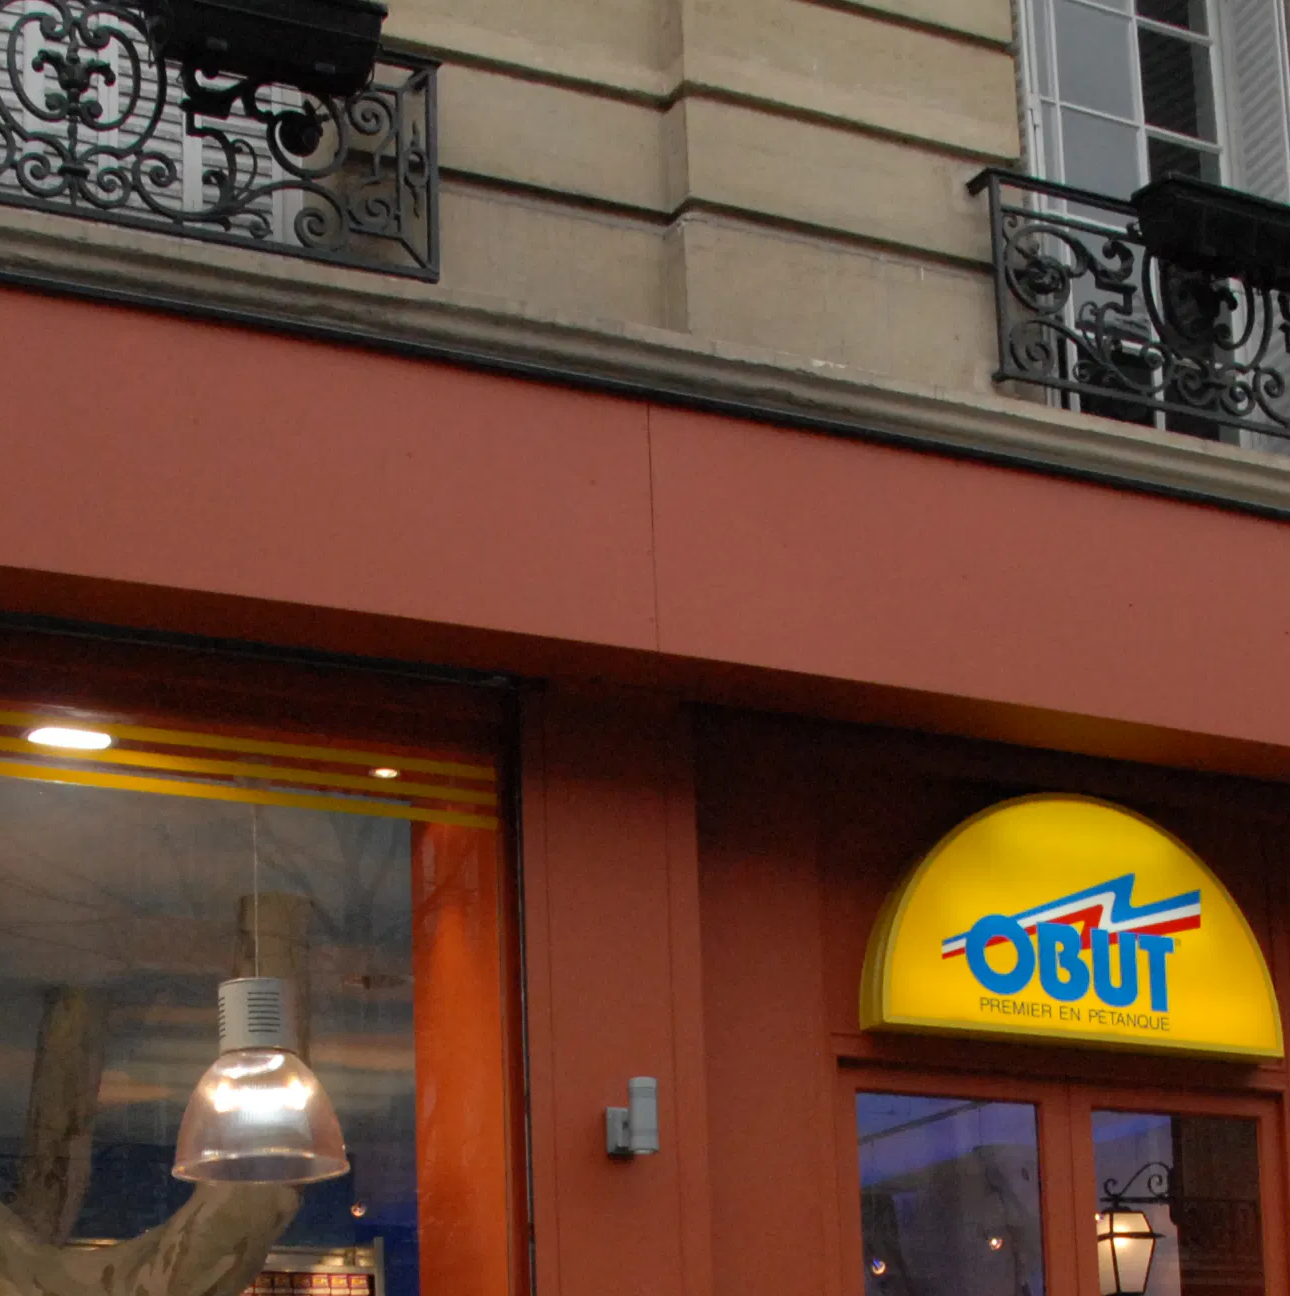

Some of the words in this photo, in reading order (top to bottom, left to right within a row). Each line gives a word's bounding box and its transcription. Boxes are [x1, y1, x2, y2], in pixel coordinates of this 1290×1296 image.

[966, 914, 1175, 1013] OBUT
[979, 997, 1052, 1018] PREMIER
[1059, 1005, 1081, 1022] EN
